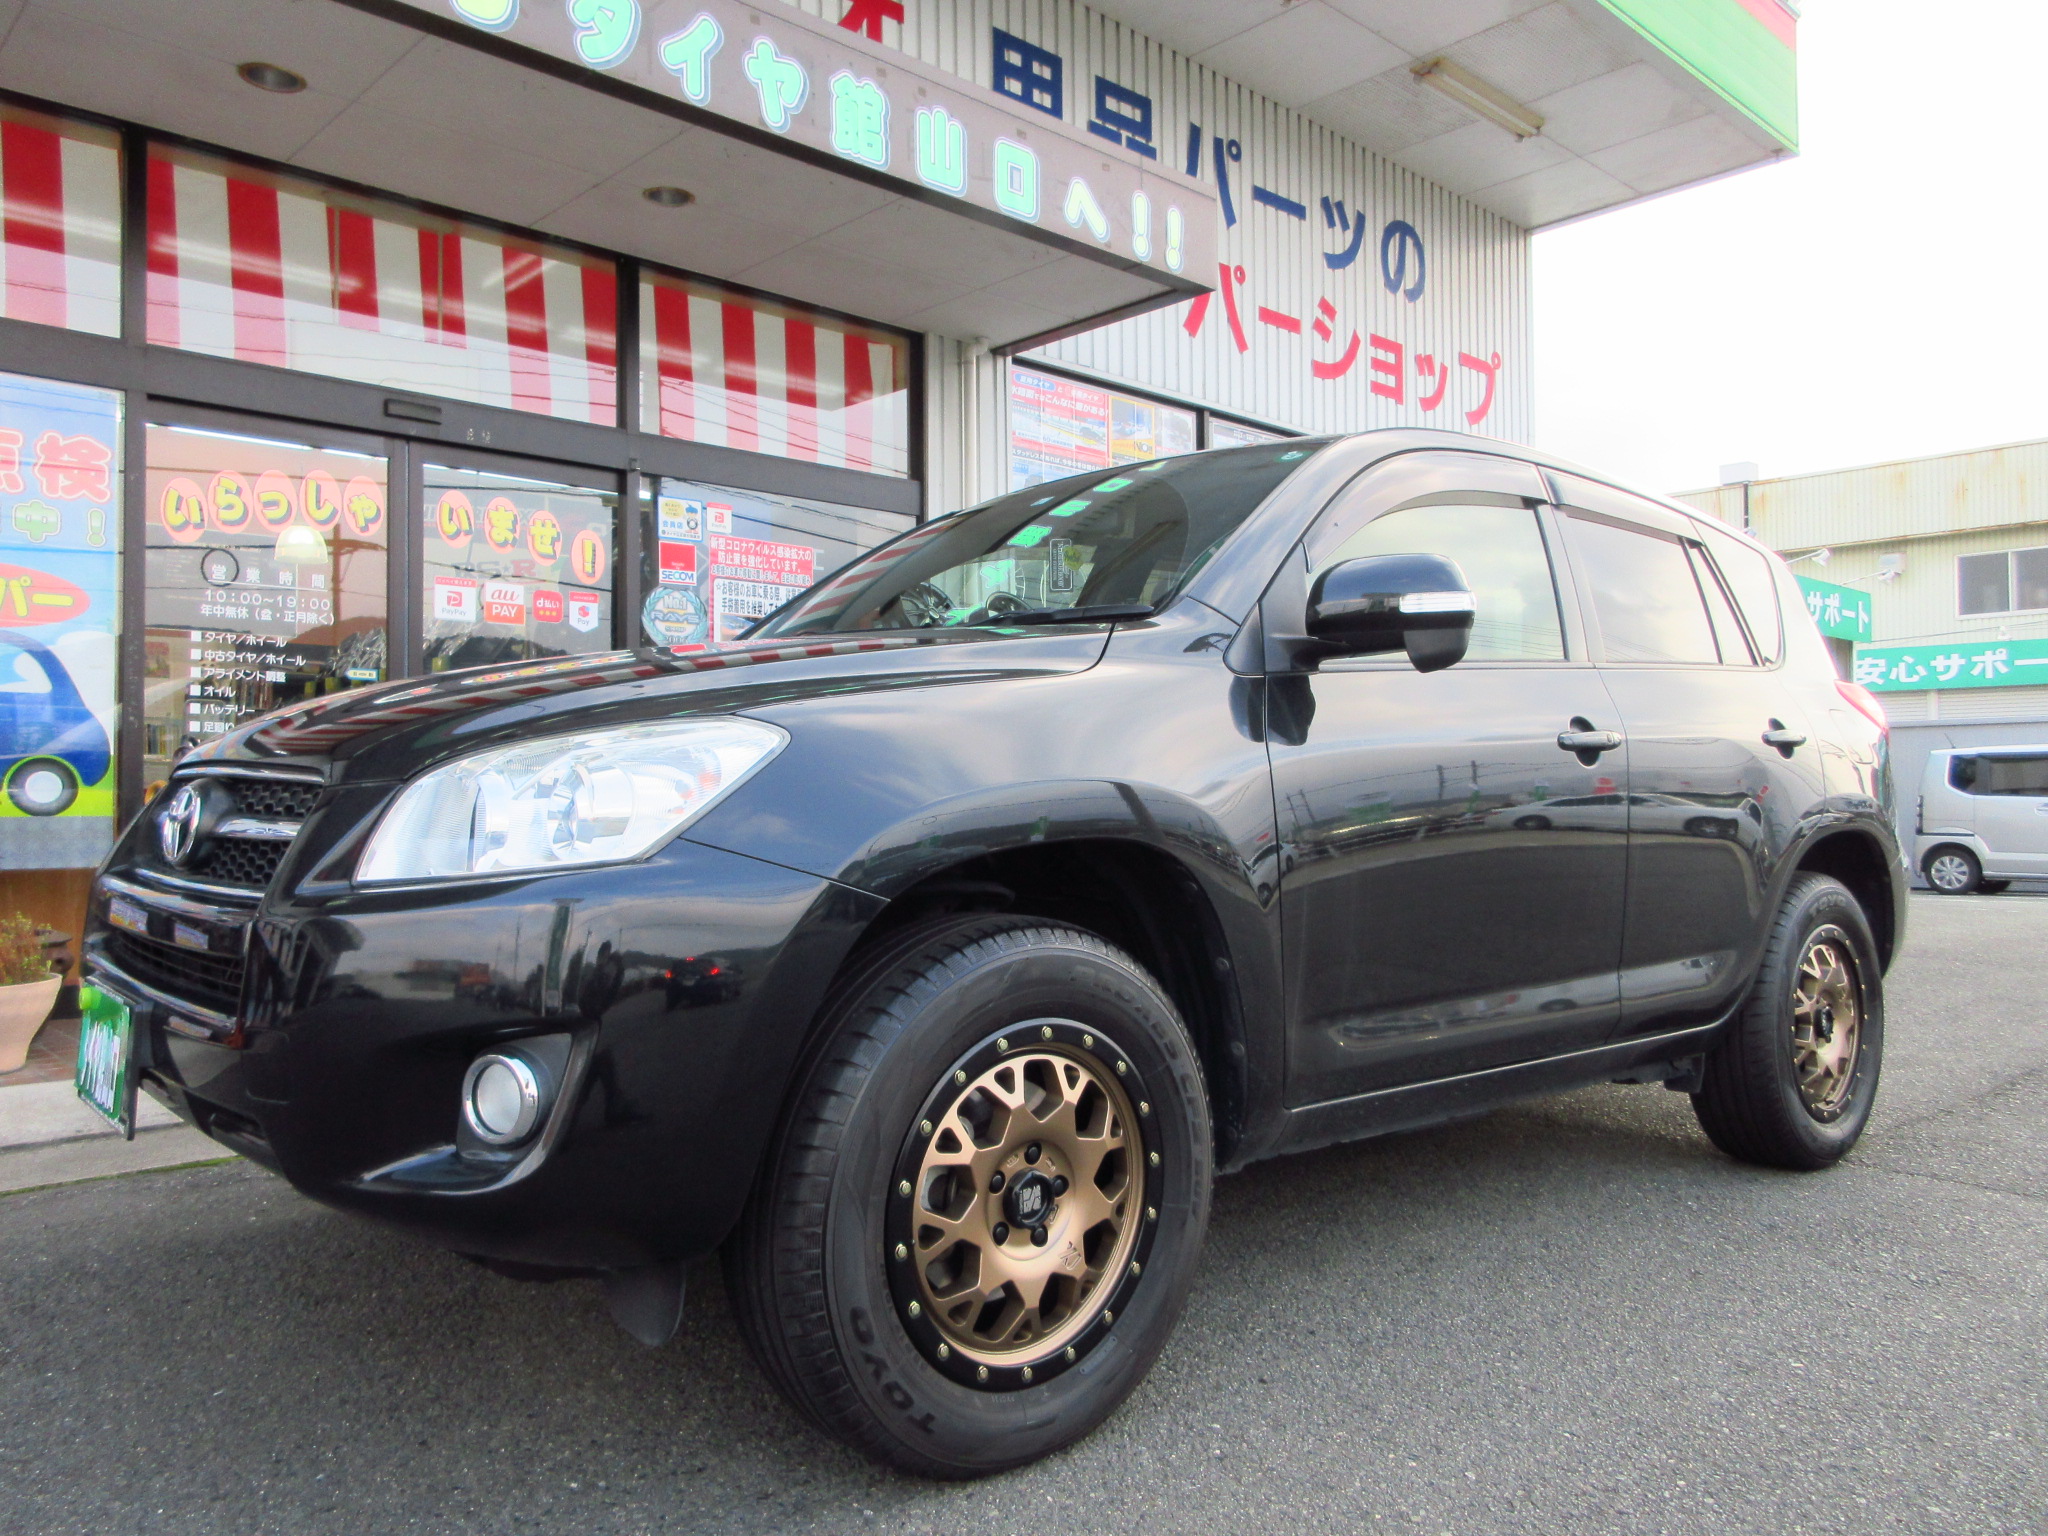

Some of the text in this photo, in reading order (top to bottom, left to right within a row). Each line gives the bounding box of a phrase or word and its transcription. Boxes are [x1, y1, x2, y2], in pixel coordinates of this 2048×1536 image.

[448, 0, 1188, 272] タイヤ館山口へ!!
[164, 477, 381, 532] いらっしゃ
[439, 503, 596, 577] いませ!
[710, 536, 812, 561] 新型コロナウイルス感染拡大の
[211, 564, 325, 589] 営業時間
[661, 570, 694, 582] SECOM
[491, 589, 520, 602] au
[536, 597, 560, 608] d払い
[441, 607, 467, 616] PayPay
[492, 604, 518, 617] PAY
[1807, 590, 1869, 634] サポート
[577, 618, 590, 626] Pay
[1855, 647, 2048, 684] 安心サポー
[203, 667, 286, 683] アライメント調整
[203, 685, 237, 699] オイル
[203, 703, 256, 716] バッテリー
[849, 1305, 936, 1434] TOYO
